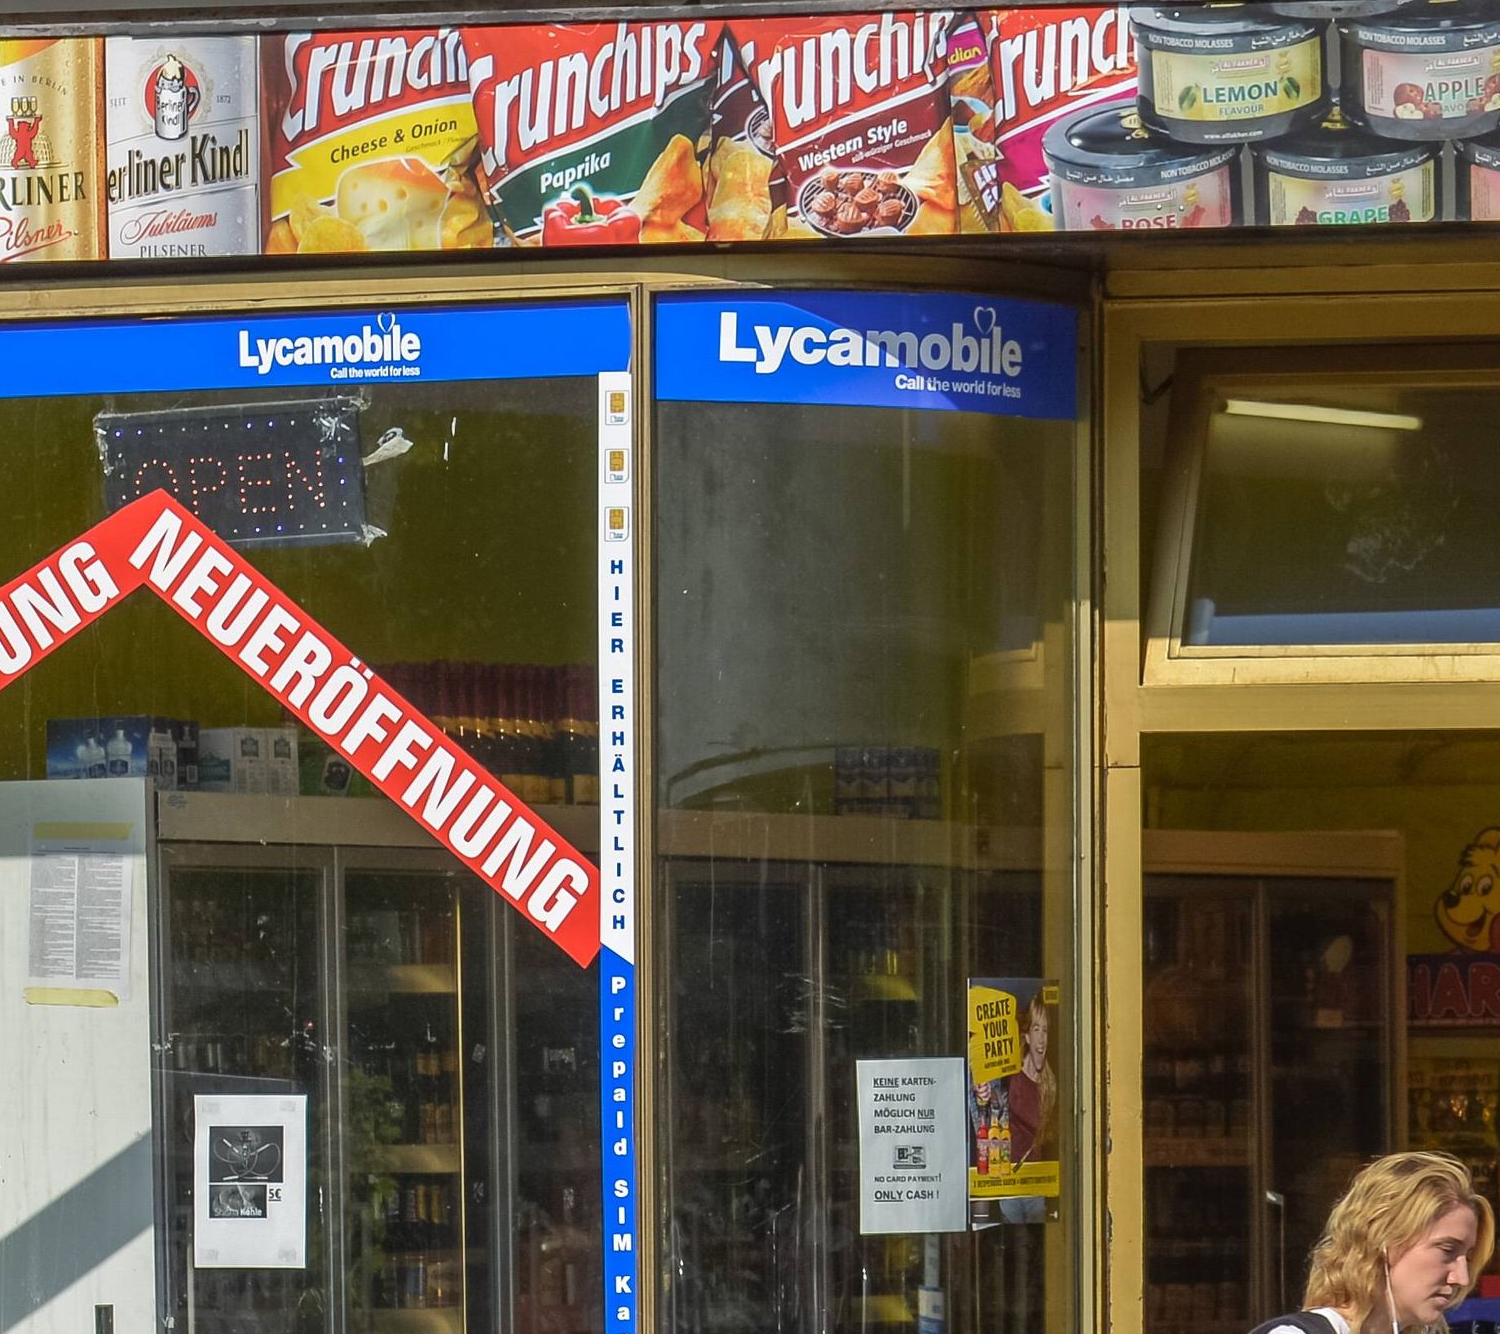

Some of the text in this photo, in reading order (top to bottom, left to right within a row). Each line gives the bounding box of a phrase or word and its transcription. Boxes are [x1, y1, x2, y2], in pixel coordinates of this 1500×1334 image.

[12, 75, 25, 84] IN
[31, 74, 70, 96] BERLIN
[1202, 80, 1279, 104] LEMON
[1425, 76, 1484, 102] APPLE
[1219, 104, 1265, 116] FLAVOUR
[330, 117, 458, 164] Cheese & Onion
[799, 118, 909, 173] Western Style
[107, 127, 251, 205] erliner Kindl
[540, 151, 611, 195] Paprika
[120, 210, 219, 247] Jubiläums
[239, 313, 421, 374] Lycamobile
[895, 375, 1021, 399] Call the world for less
[128, 508, 590, 934] NEUERÖFFNUNG
[975, 997, 1011, 1023] CREATE
[982, 1019, 1009, 1040] YOUR
[984, 1036, 1014, 1060] PARTY
[873, 1077, 937, 1088] KEINE KARTEN-
[873, 1093, 916, 1102] ZAHLUNG
[874, 1107, 935, 1119] MÖGLICH NUR
[874, 1125, 935, 1134] BAR-ZAHLUNG
[268, 1188, 282, 1202] 5€
[874, 1190, 934, 1202] ONLY CASH
[612, 1178, 633, 1253] SIM
